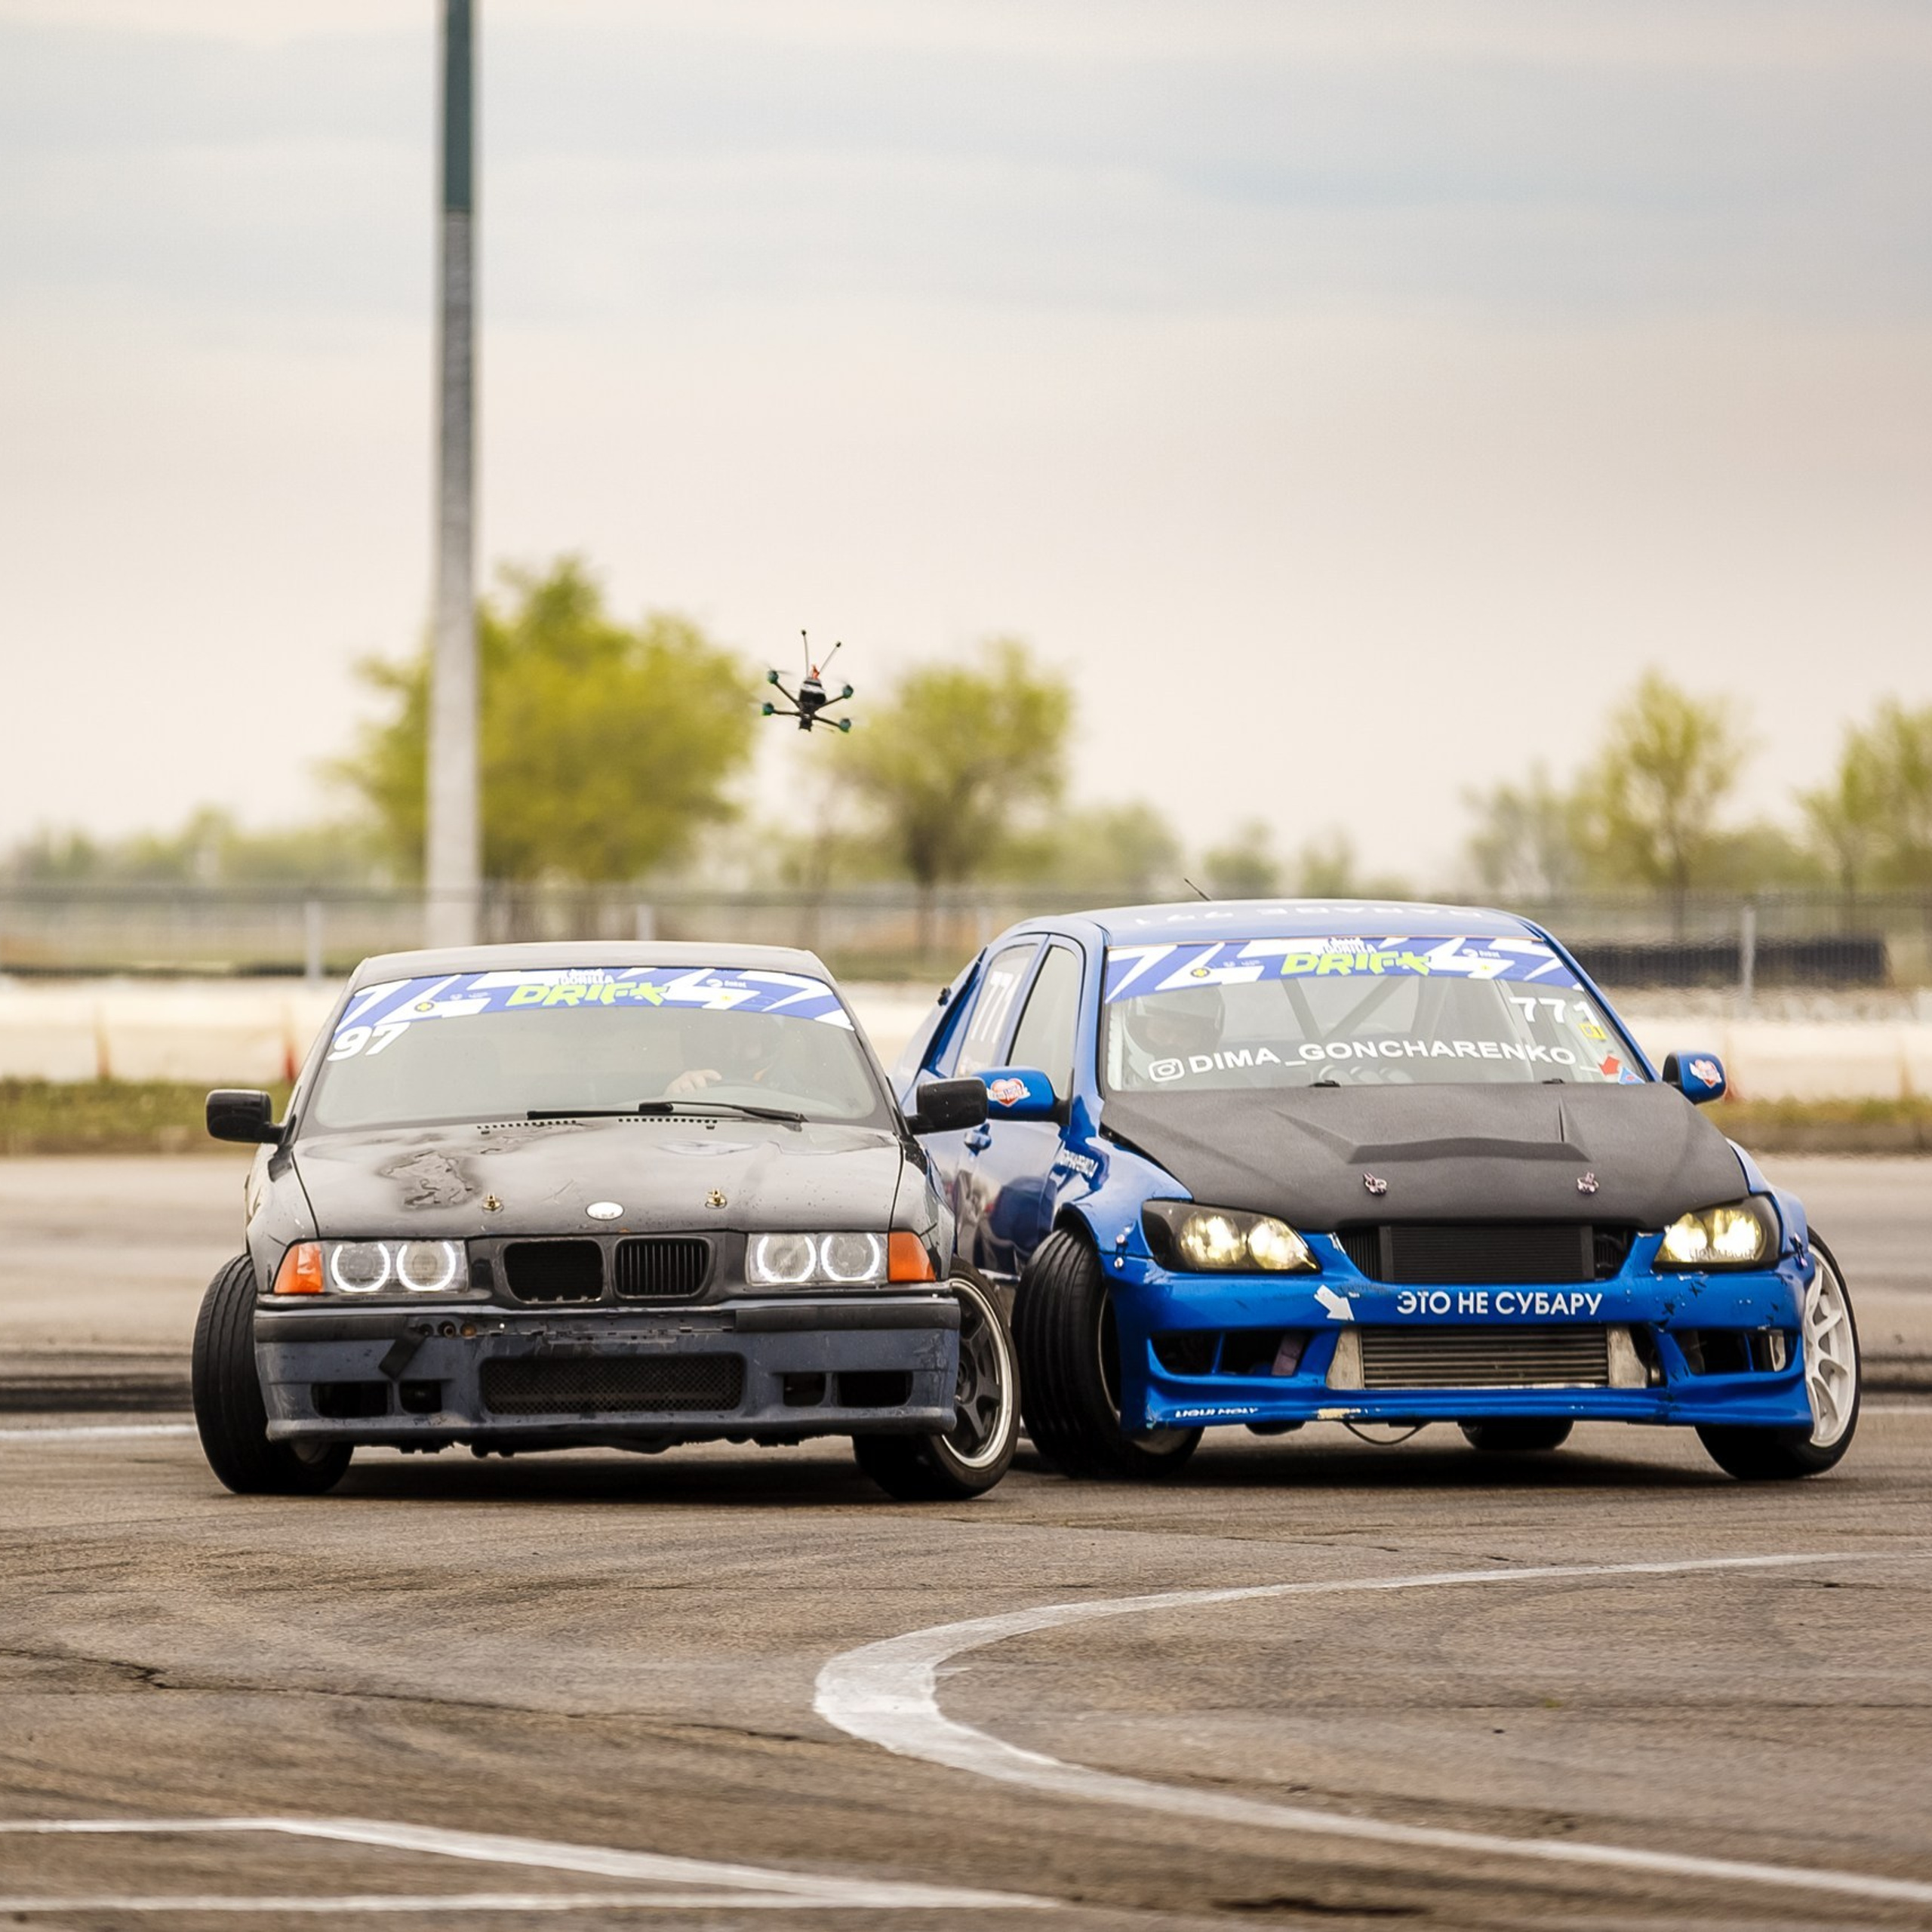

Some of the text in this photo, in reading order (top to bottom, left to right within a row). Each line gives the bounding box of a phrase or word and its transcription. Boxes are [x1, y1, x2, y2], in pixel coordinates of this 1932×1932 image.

[1281, 951, 1429, 977] DRIFT
[505, 982, 666, 1007] DRIFT
[1509, 996, 1600, 1027] 771
[326, 1021, 411, 1062] 97
[1397, 1291, 1602, 1315] ЭТО НЕ СУБАРУ
